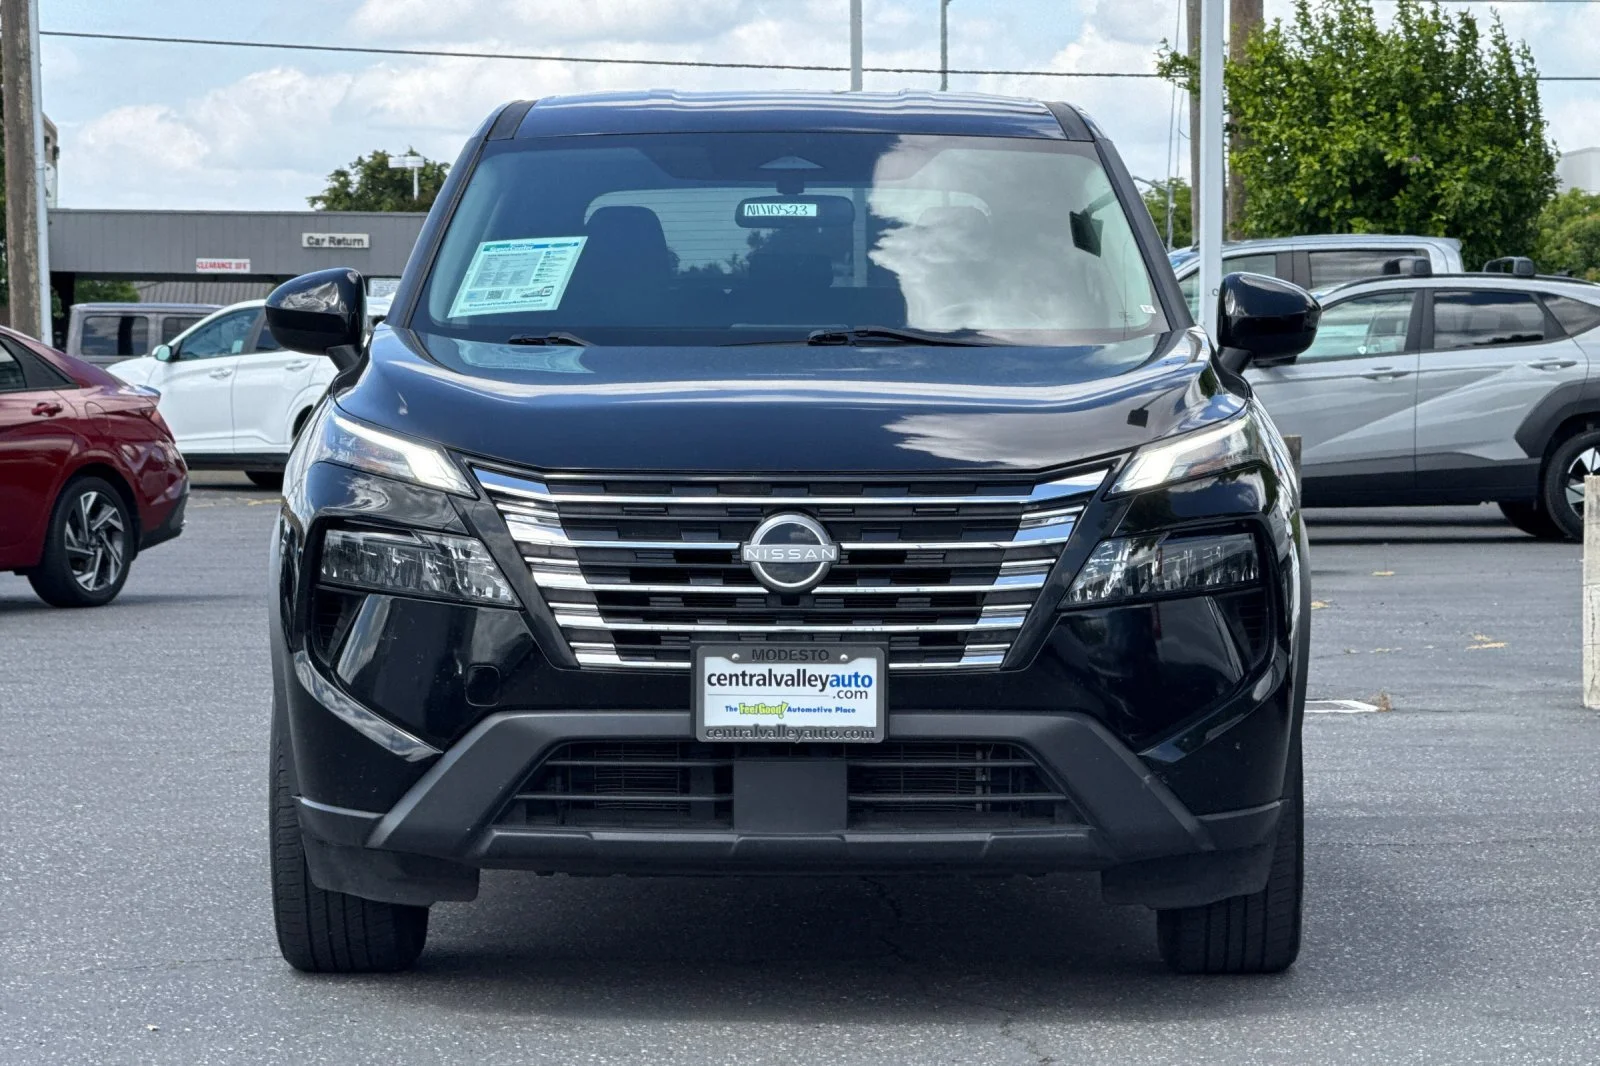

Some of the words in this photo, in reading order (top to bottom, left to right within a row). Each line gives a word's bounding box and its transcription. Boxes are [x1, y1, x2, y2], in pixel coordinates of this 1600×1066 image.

[307, 235, 325, 246] Car
[328, 236, 365, 247] Return
[746, 548, 835, 560] NISSAN
[752, 649, 830, 661] MODESTO
[707, 668, 873, 692] centralvalleyauto
[832, 690, 868, 700] .com
[787, 705, 832, 714] Automotive
[706, 723, 875, 743] centralvalleyauto.com
